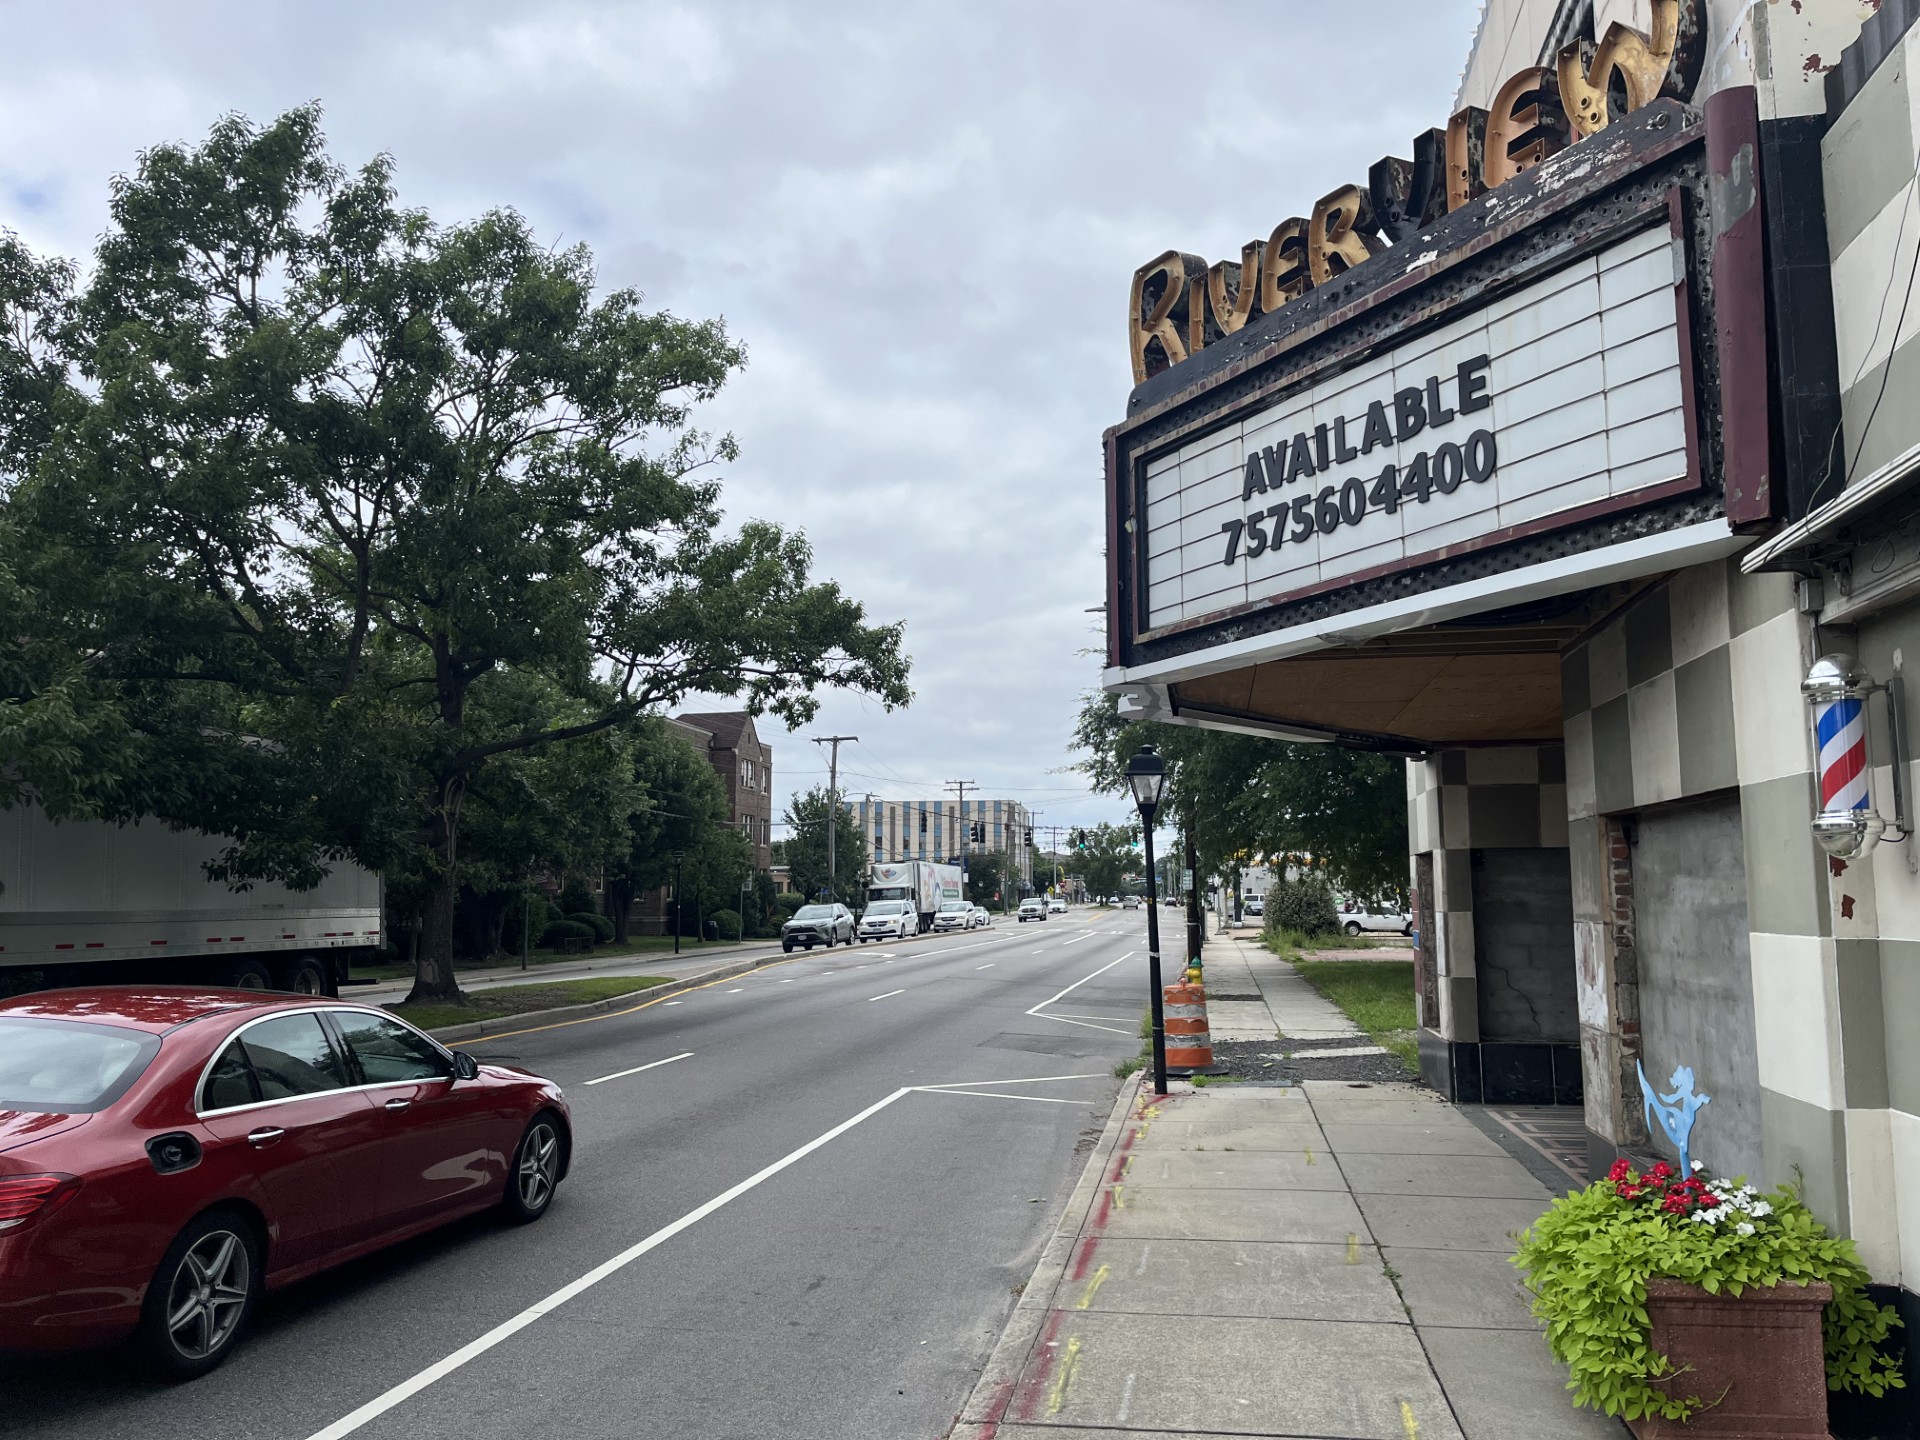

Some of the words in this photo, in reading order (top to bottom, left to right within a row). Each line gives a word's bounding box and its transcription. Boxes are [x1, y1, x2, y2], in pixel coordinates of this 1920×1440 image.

[1129, 0, 1706, 386] RIVERVIEW
[1221, 429, 1497, 565] 7575604400
[1242, 354, 1490, 501] AVAILABLE
